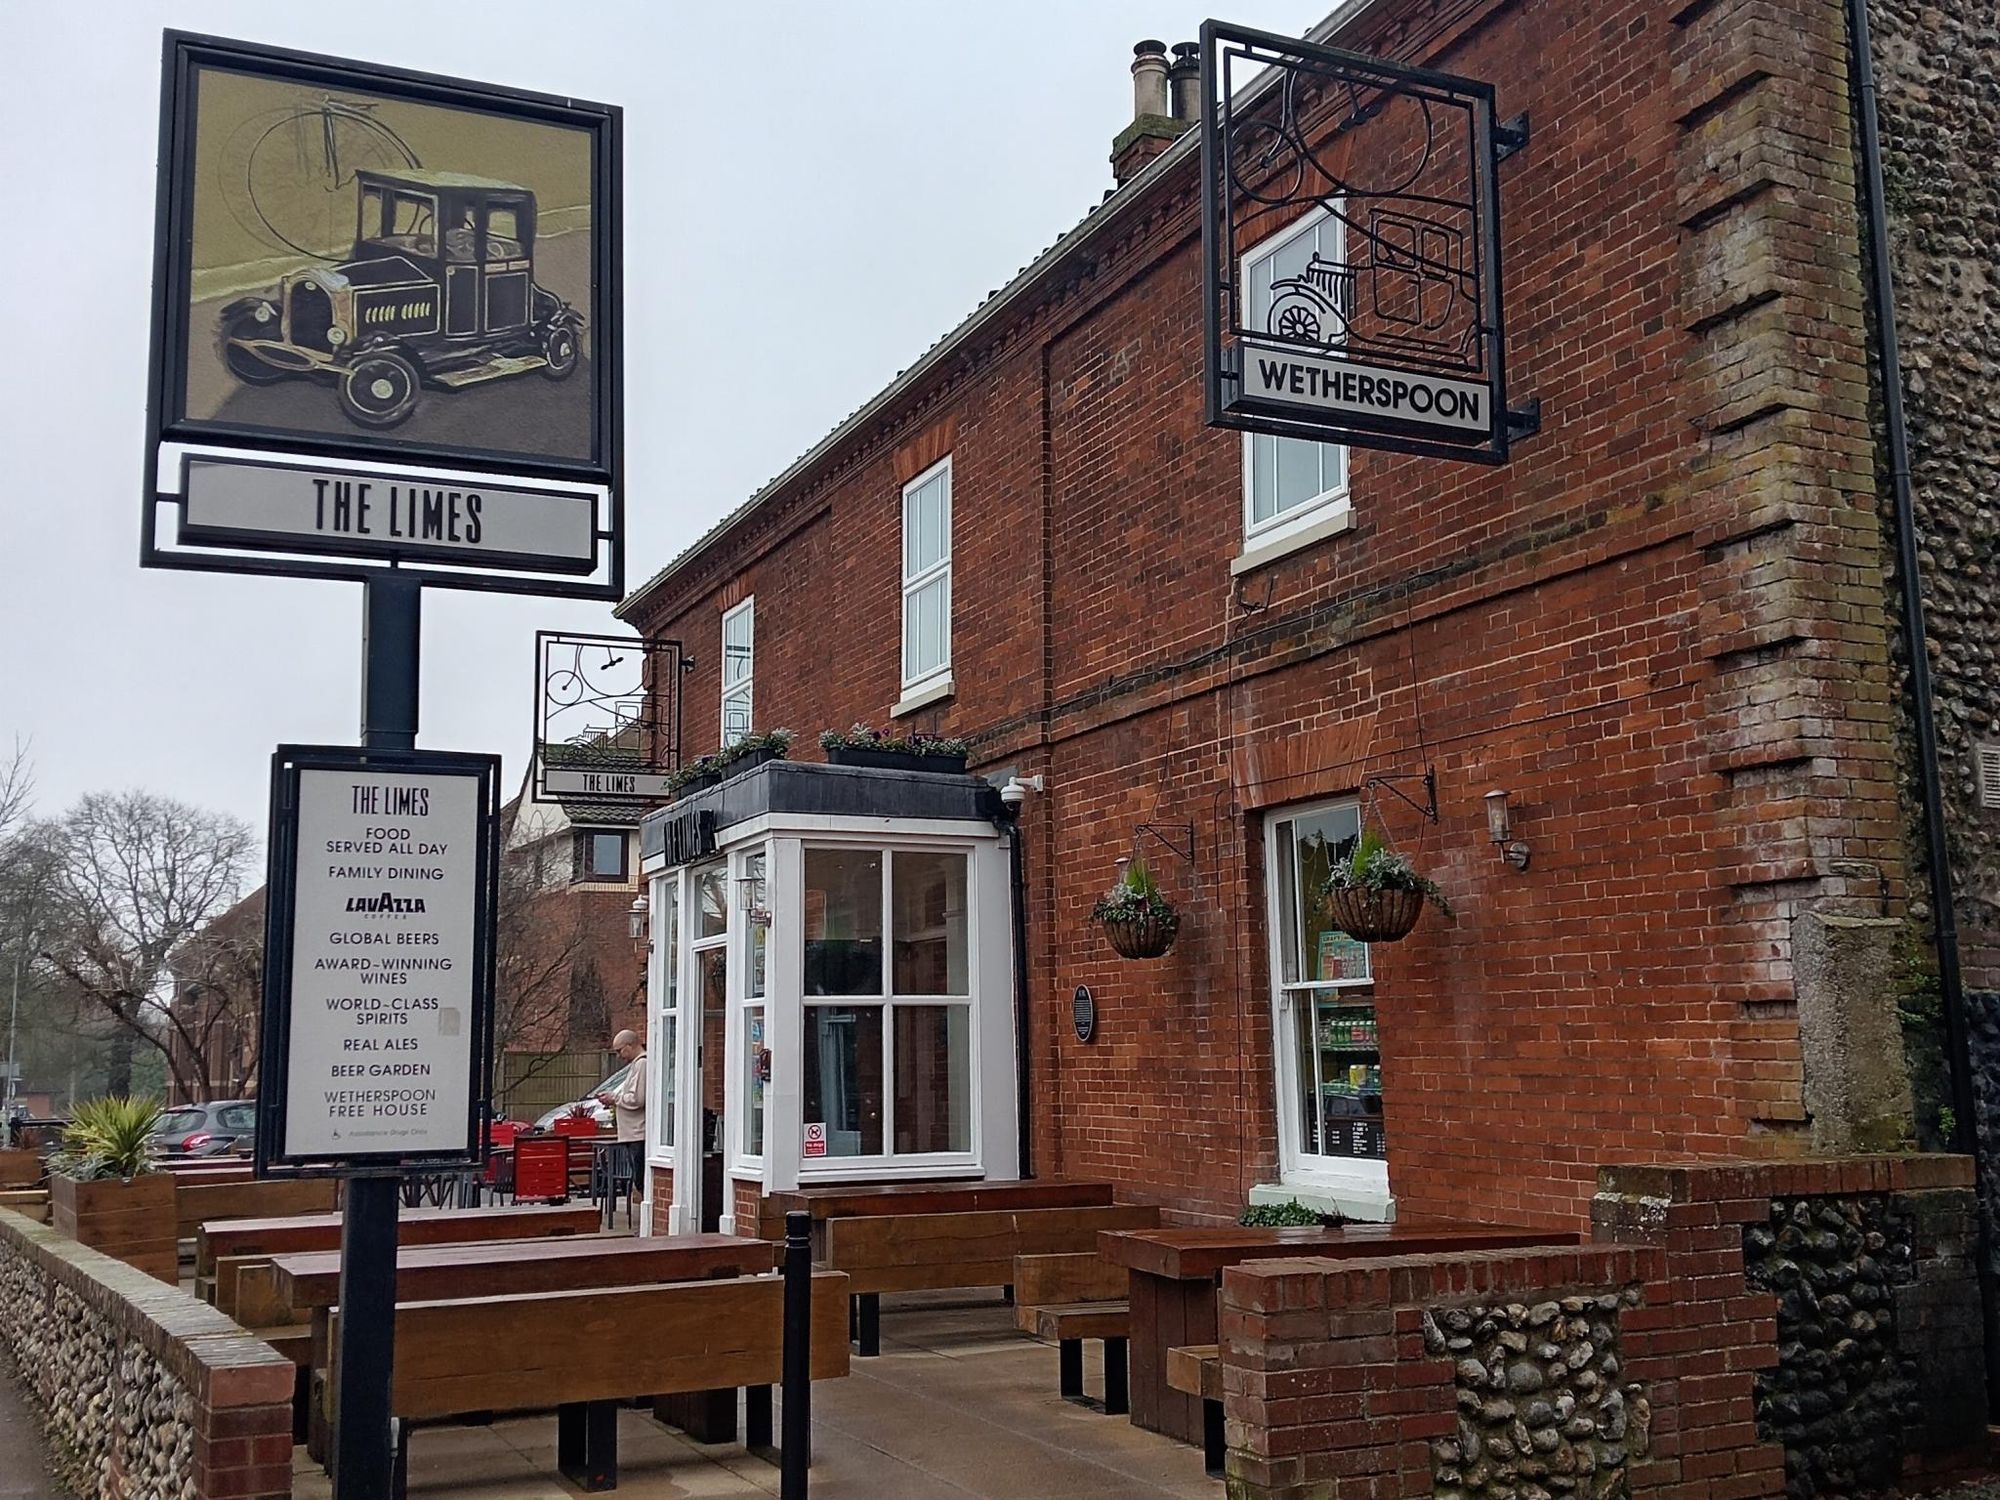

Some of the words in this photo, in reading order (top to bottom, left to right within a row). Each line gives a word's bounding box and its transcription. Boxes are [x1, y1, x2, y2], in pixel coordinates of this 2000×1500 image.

[1257, 358, 1479, 421] WETHERSPOON
[312, 478, 372, 535] THE
[389, 485, 483, 544] LIMES
[582, 773, 602, 792] THE
[606, 775, 636, 793] LIMES
[351, 785, 380, 815] THE
[384, 786, 430, 817] LIMES
[366, 827, 411, 840] FOOD
[326, 840, 383, 853] SERVED
[388, 842, 414, 854] ALL
[418, 843, 448, 855] DAY
[328, 866, 383, 879] FAMILY
[388, 867, 445, 881] DINING
[345, 892, 426, 913] LAVAZZA
[329, 932, 392, 945] GLOBAL
[397, 933, 440, 945] BEERS
[360, 972, 408, 985] WINES
[356, 1012, 408, 1025] SPIRITS
[343, 1039, 380, 1051] REAL
[383, 1038, 419, 1050] ALES
[331, 1065, 365, 1077] BEER
[368, 1063, 431, 1077] GARDEN
[323, 1089, 436, 1103] WETHERSPOON
[329, 1104, 365, 1118] FREE
[372, 1103, 428, 1117] HOUSE
